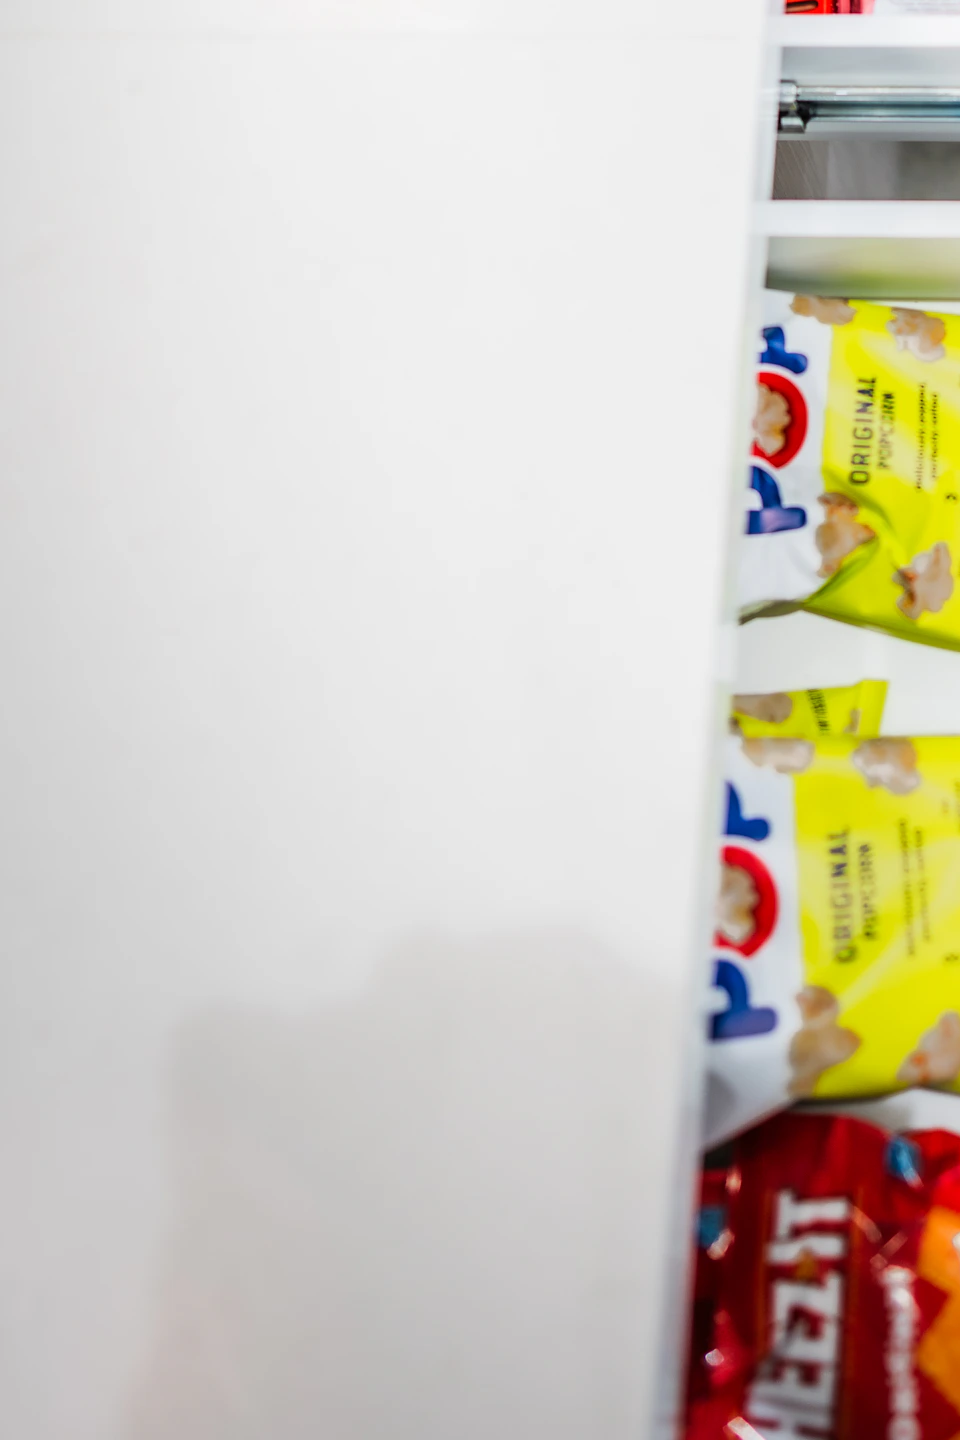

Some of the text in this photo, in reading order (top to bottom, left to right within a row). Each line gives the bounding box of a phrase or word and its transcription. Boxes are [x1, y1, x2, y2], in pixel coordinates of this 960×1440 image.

[850, 375, 877, 487] ORIGINAL
[877, 391, 896, 470] POPCORN
[831, 824, 859, 965] ORIGINAL
